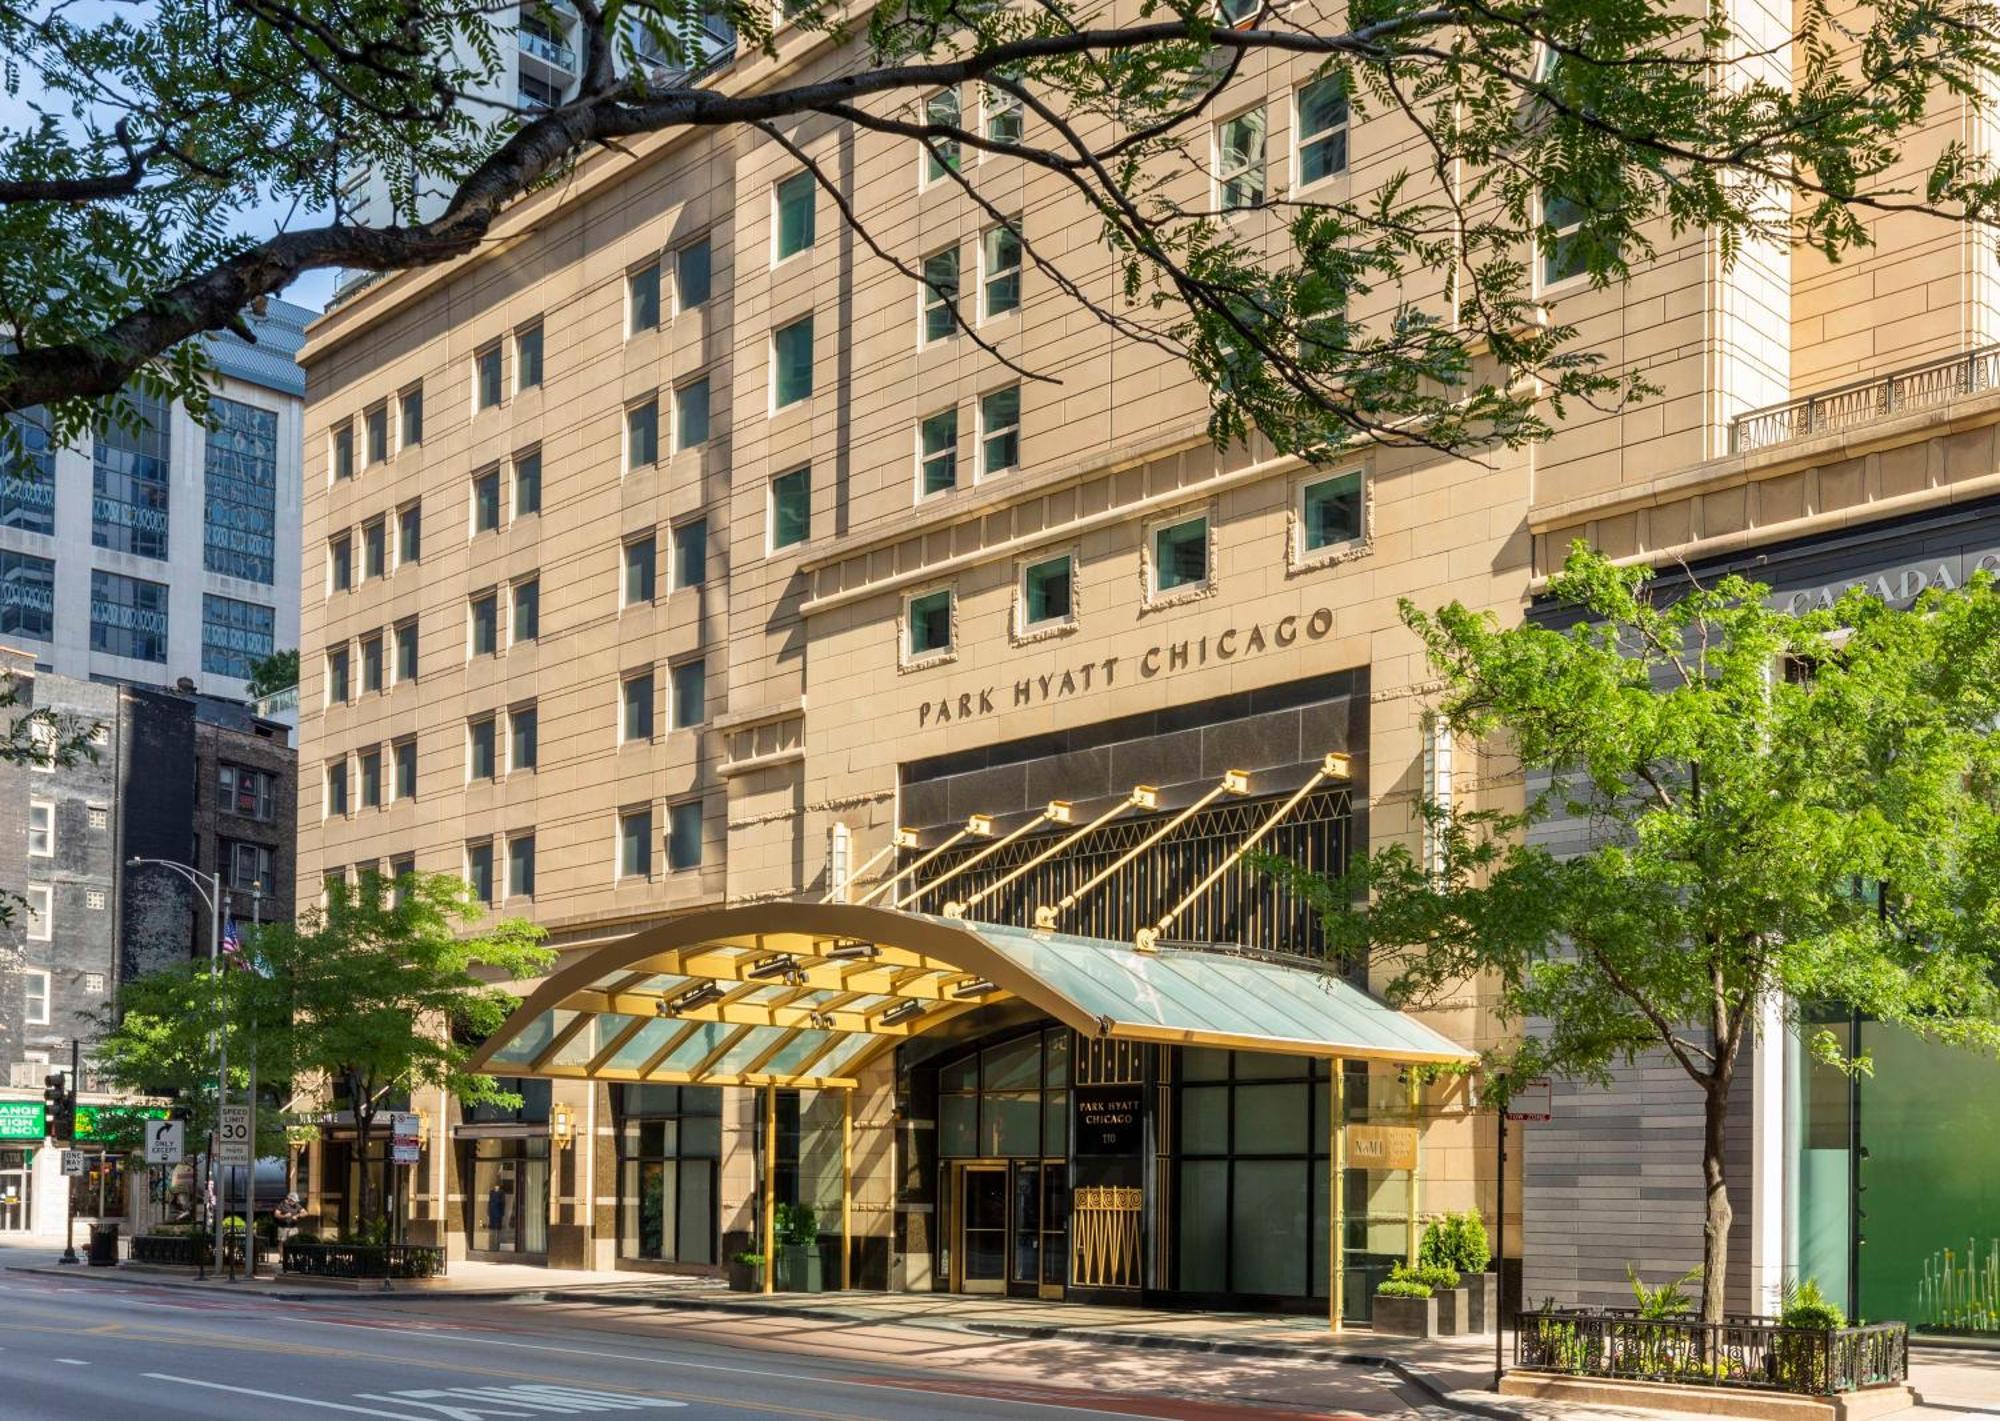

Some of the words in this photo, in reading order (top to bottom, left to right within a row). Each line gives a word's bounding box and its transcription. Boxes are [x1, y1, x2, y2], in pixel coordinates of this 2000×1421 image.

[1787, 563, 1955, 618] CAADA
[919, 686, 994, 728] PARK
[1014, 657, 1119, 708] HYATT
[1140, 607, 1333, 679] CHICAGO
[223, 1108, 248, 1116] SPEED
[1080, 1102, 1104, 1112] PARK
[1108, 1101, 1139, 1111] HYATT
[1086, 1114, 1133, 1125] CHICAGO
[223, 1124, 247, 1138] 30
[66, 1152, 82, 1160] ONE
